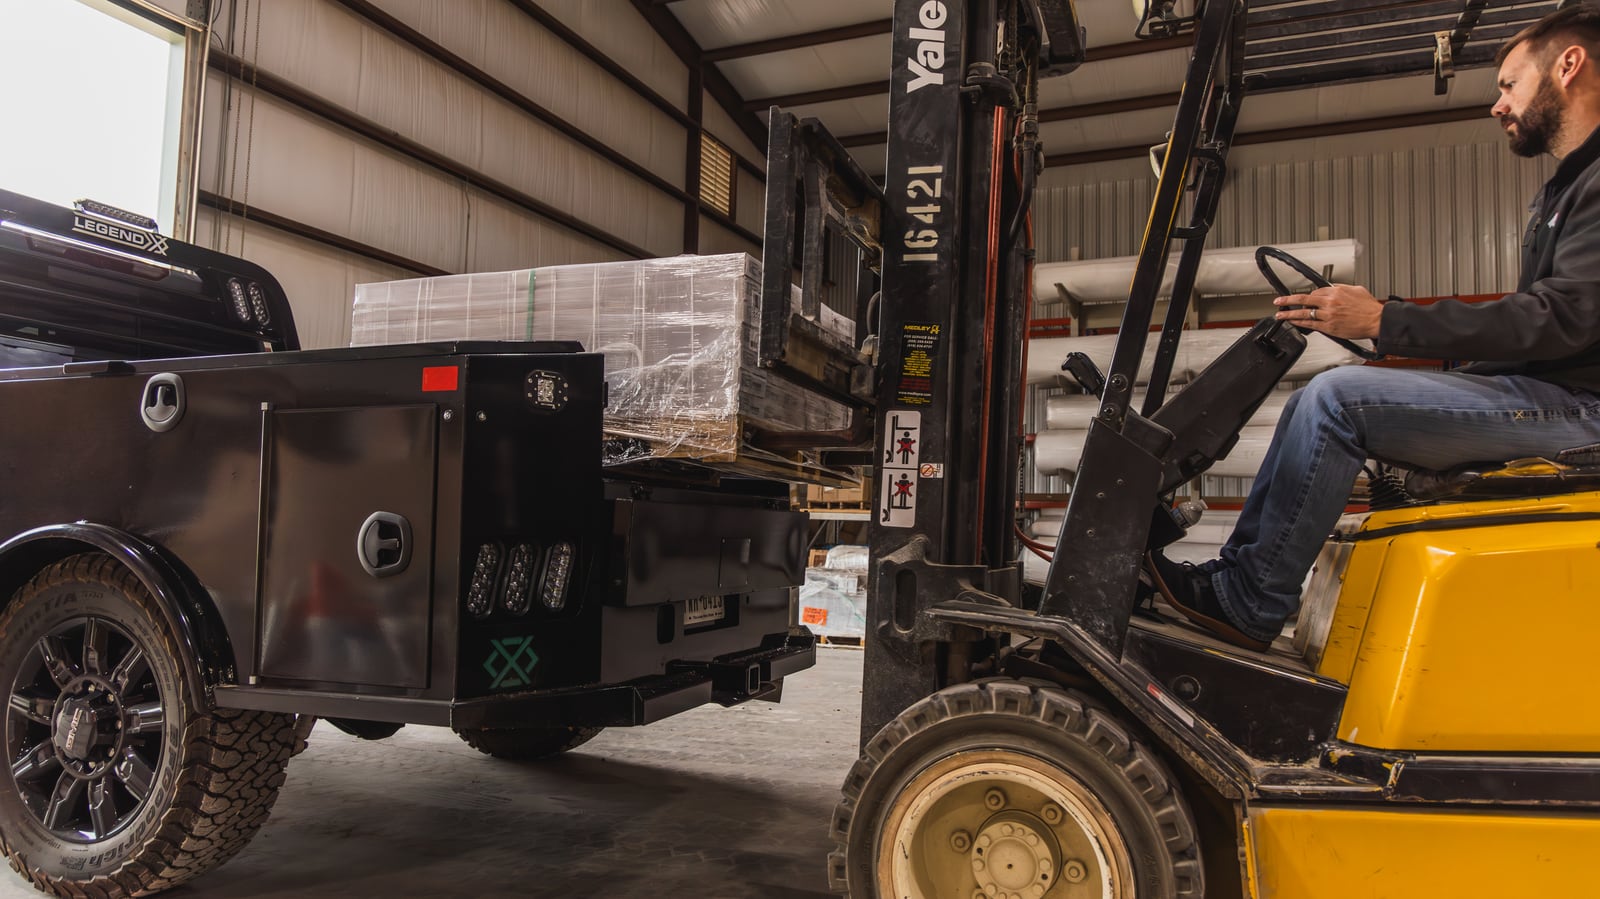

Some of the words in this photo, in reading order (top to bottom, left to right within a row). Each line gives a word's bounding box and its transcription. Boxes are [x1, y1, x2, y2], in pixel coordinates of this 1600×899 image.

[906, 0, 948, 94] Yale
[902, 165, 943, 262] 16421
[65, 707, 84, 750] GMC
